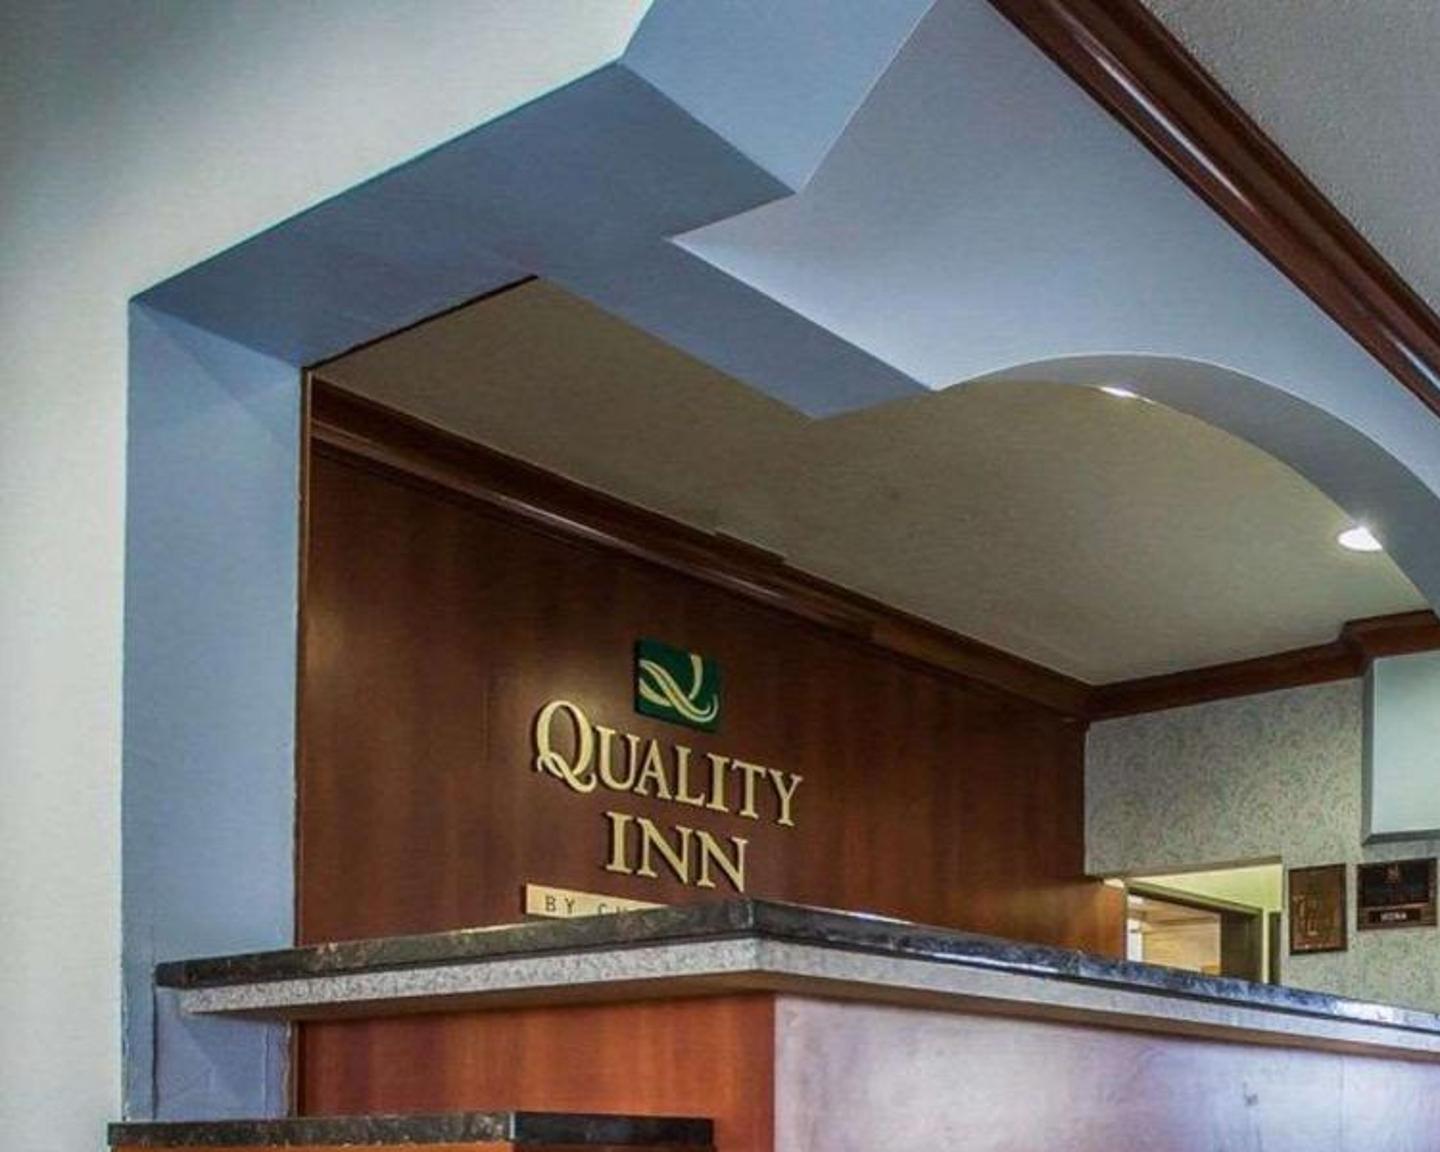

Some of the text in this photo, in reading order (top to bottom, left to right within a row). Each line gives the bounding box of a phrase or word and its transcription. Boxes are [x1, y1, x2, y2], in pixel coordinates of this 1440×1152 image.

[536, 700, 803, 826] QUALITY
[606, 811, 749, 892] INN
[544, 895, 576, 915] BY
